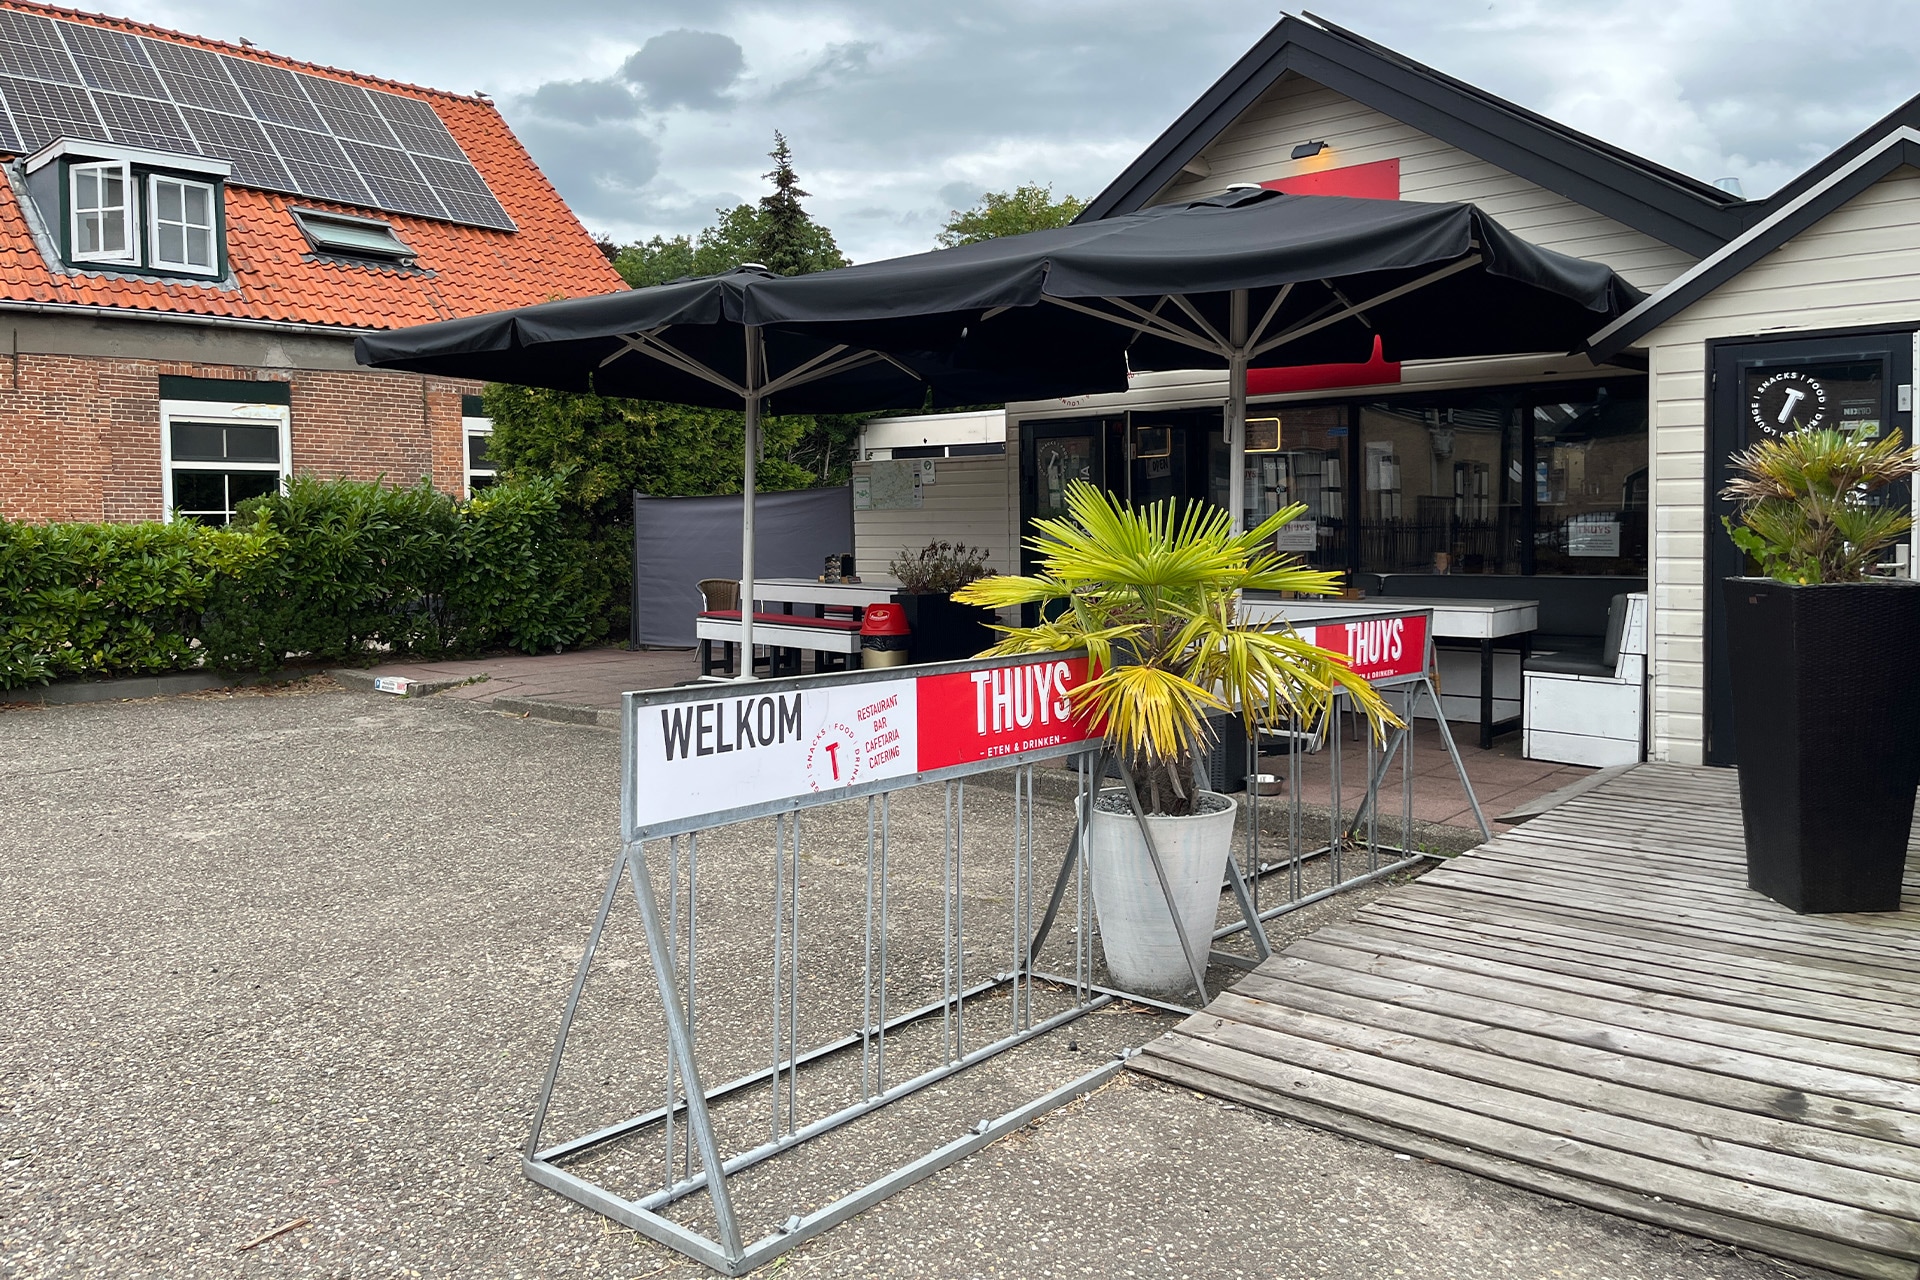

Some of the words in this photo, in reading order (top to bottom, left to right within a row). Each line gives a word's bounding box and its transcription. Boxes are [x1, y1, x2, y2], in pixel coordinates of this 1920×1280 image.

[1757, 371, 1798, 394] SNACKS
[1806, 377, 1826, 403] FOOD
[1777, 387, 1805, 424] T
[1751, 402, 1777, 437] LOUNGE
[1152, 457, 1169, 472] OPEN
[1576, 525, 1612, 535] THUYS
[1344, 618, 1404, 668] THUYS
[1371, 669, 1394, 679] DRINKEN
[856, 693, 898, 722] RESTAURANT
[970, 661, 1072, 736] THUYS
[660, 692, 802, 762] WELKOM
[873, 716, 888, 732] BAR
[864, 728, 900, 754] CAFETARIA
[987, 744, 1011, 757] ETEN
[1014, 742, 1020, 752] &
[1022, 734, 1060, 750] DRINKEN
[806, 728, 826, 770] SNACKS
[833, 722, 855, 739] FOOD
[846, 748, 861, 787] DRINKS
[825, 741, 841, 782] T
[868, 745, 900, 769] CATERING
